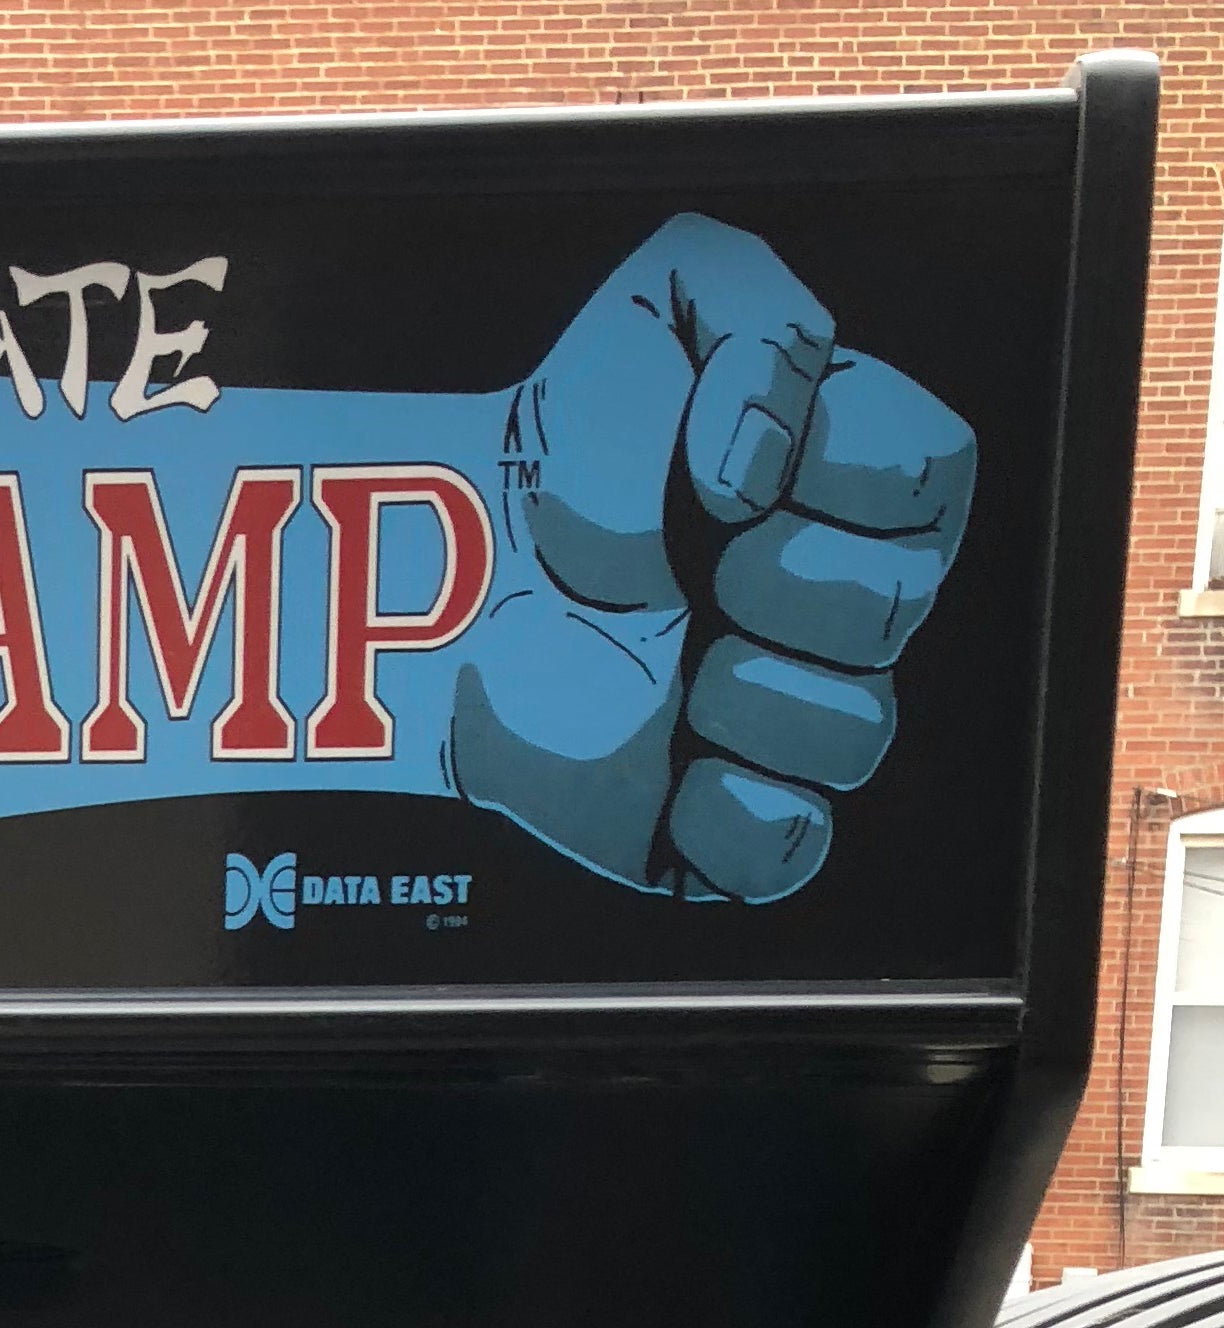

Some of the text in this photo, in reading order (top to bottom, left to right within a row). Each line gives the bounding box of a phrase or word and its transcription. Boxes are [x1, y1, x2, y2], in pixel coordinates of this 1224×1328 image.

[498, 460, 542, 490] TM
[303, 875, 472, 905] DATA EAST
